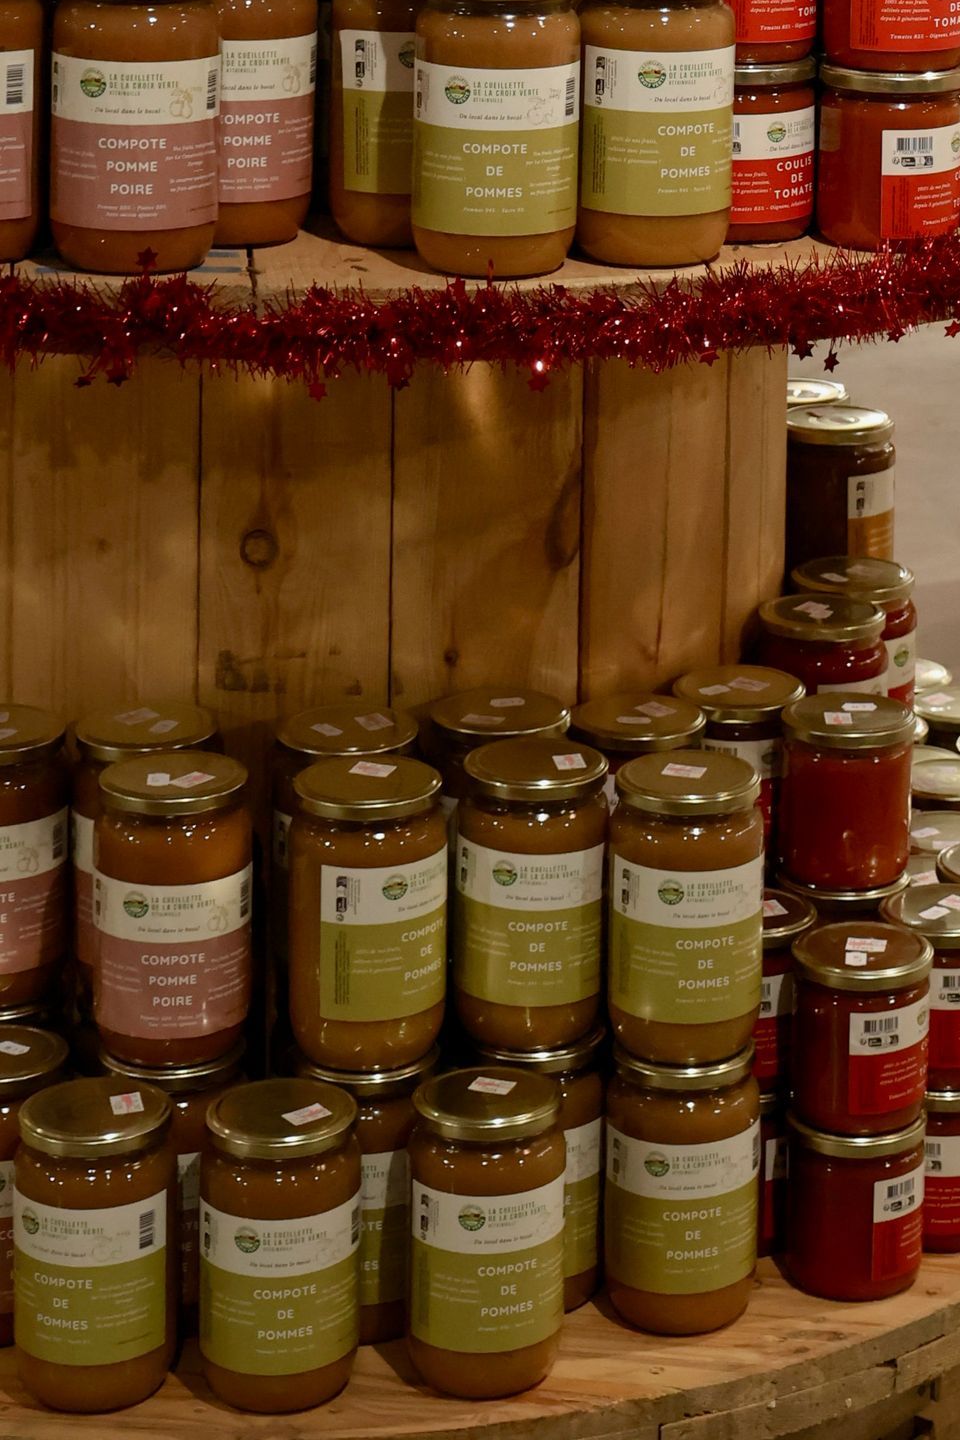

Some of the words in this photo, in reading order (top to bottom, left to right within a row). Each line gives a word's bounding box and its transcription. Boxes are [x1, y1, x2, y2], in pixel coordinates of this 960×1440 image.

[950, 2, 960, 12] DE
[221, 113, 280, 125] OMPOTE
[658, 123, 715, 136] COMPOTE
[99, 138, 167, 149] COMPOTE
[224, 135, 272, 146] POMME
[463, 144, 527, 154] COMPOTE
[681, 146, 696, 156] DE
[107, 161, 157, 172] POMME
[228, 157, 267, 168] POIRE
[777, 156, 811, 171] COULIS
[486, 166, 503, 176] DE
[661, 166, 710, 178] POMMES
[791, 173, 803, 183] DE
[111, 184, 153, 195] POIRE
[466, 187, 523, 198] POMMES
[774, 183, 812, 199] TOMATE
[402, 917, 444, 942] COMPOTE
[508, 921, 568, 932] COMPOTE
[529, 943, 545, 952] DE
[676, 936, 735, 950] COMPOTE
[421, 944, 432, 956] DE
[141, 953, 205, 965] COMPOTE
[698, 960, 714, 969] DE
[405, 958, 441, 981] POMMES
[510, 961, 562, 972] POMMES
[149, 975, 197, 986] POMME
[678, 977, 729, 989] POMMES
[153, 996, 192, 1007] POIRE
[663, 1207, 722, 1222] COMPOTE
[686, 1231, 701, 1241] DE
[666, 1247, 719, 1260] POMMES
[478, 1259, 537, 1277] COMPOTE
[34, 1273, 93, 1289] COMPOTE
[253, 1284, 317, 1300] COMPOTE
[501, 1284, 517, 1296] DE
[53, 1298, 69, 1309] DE
[481, 1301, 533, 1317] POMMES
[277, 1310, 294, 1319] DE
[37, 1313, 88, 1330] POMMES
[258, 1326, 313, 1340] POMMES
